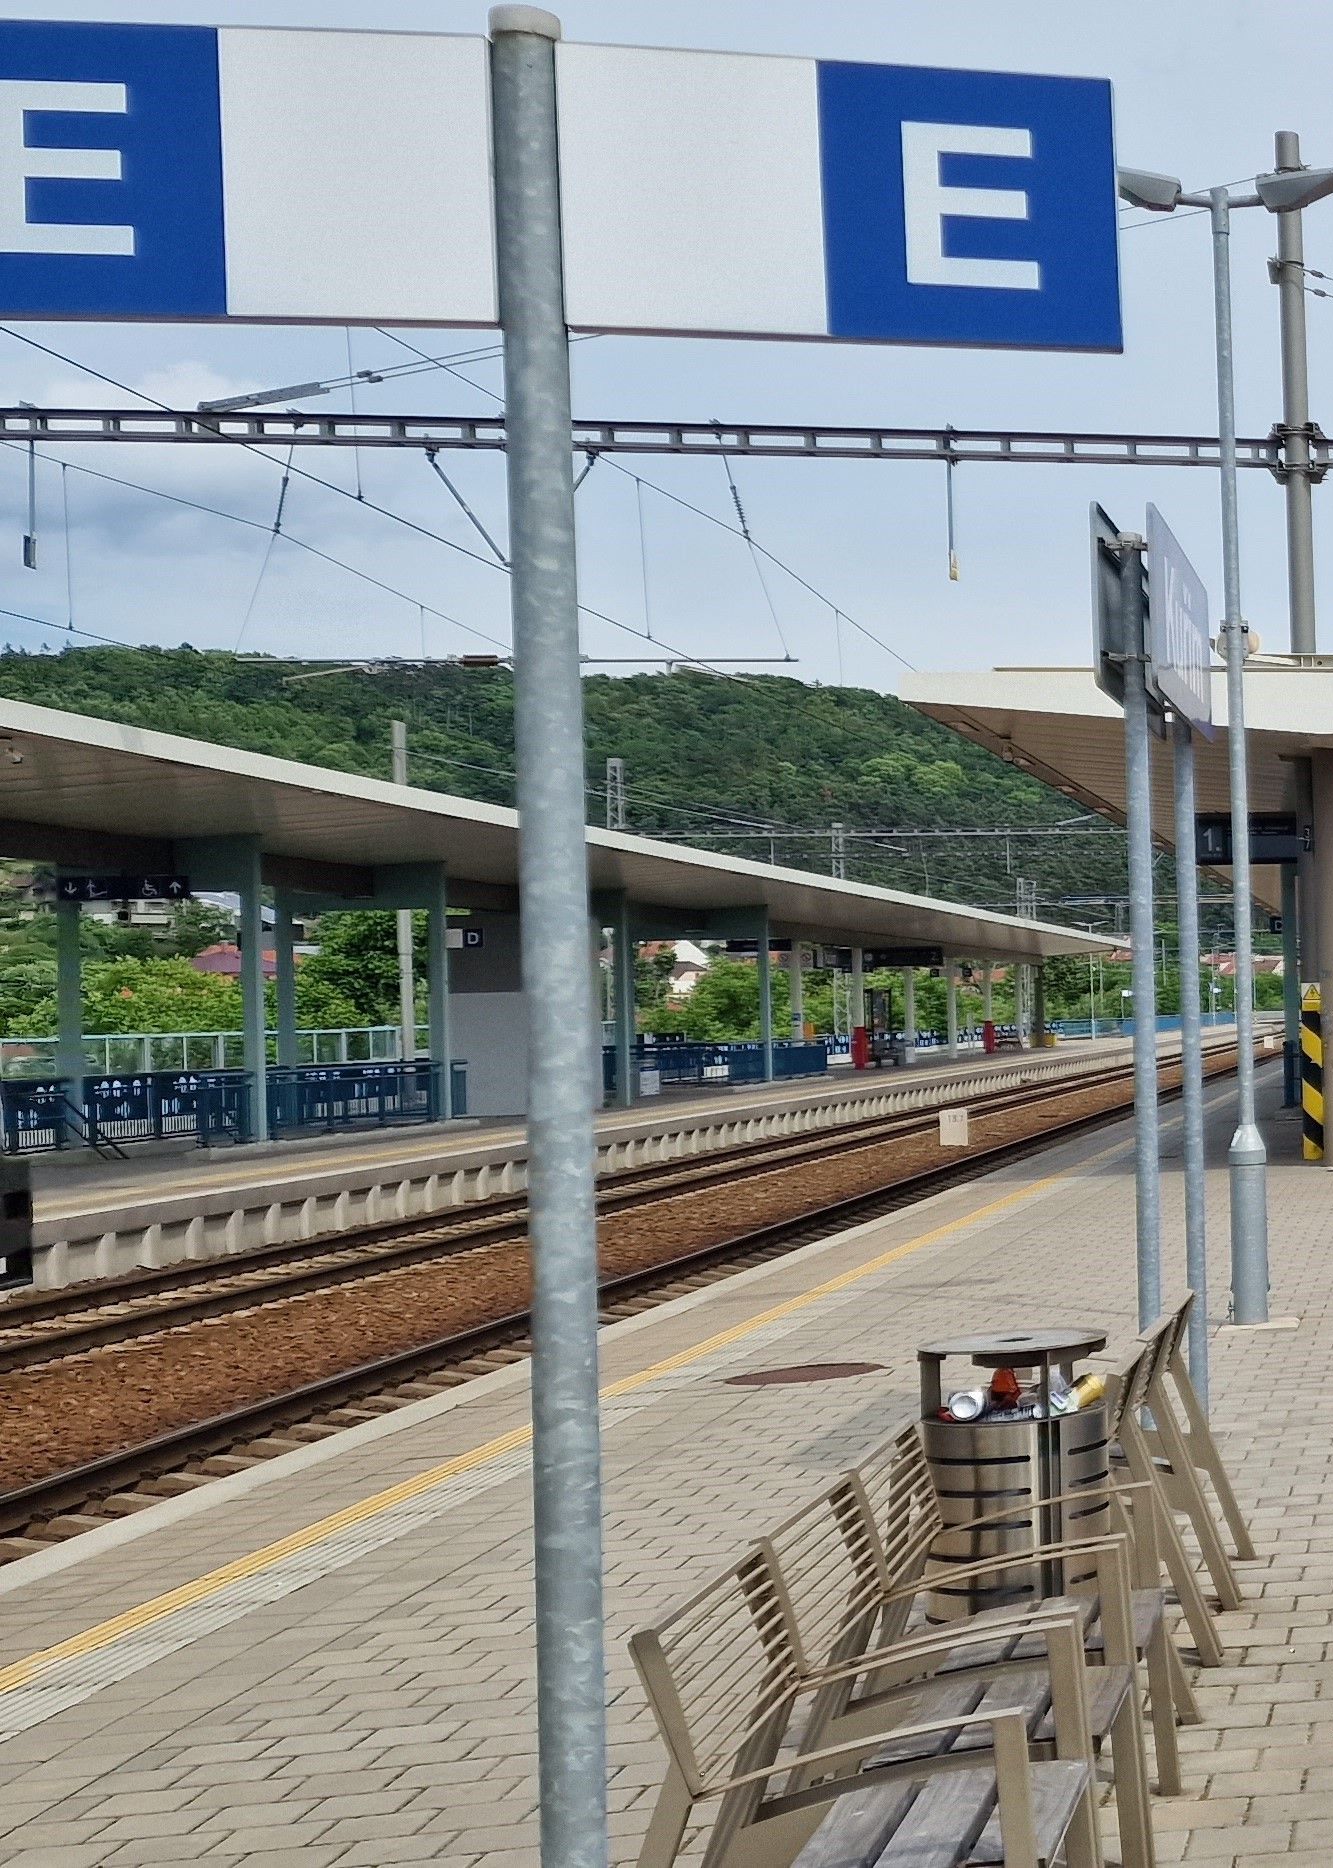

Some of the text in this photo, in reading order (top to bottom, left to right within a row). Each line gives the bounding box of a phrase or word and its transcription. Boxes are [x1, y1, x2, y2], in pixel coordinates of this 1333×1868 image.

[0, 80, 136, 256] E
[901, 120, 1040, 290] E
[467, 932, 479, 945] D
